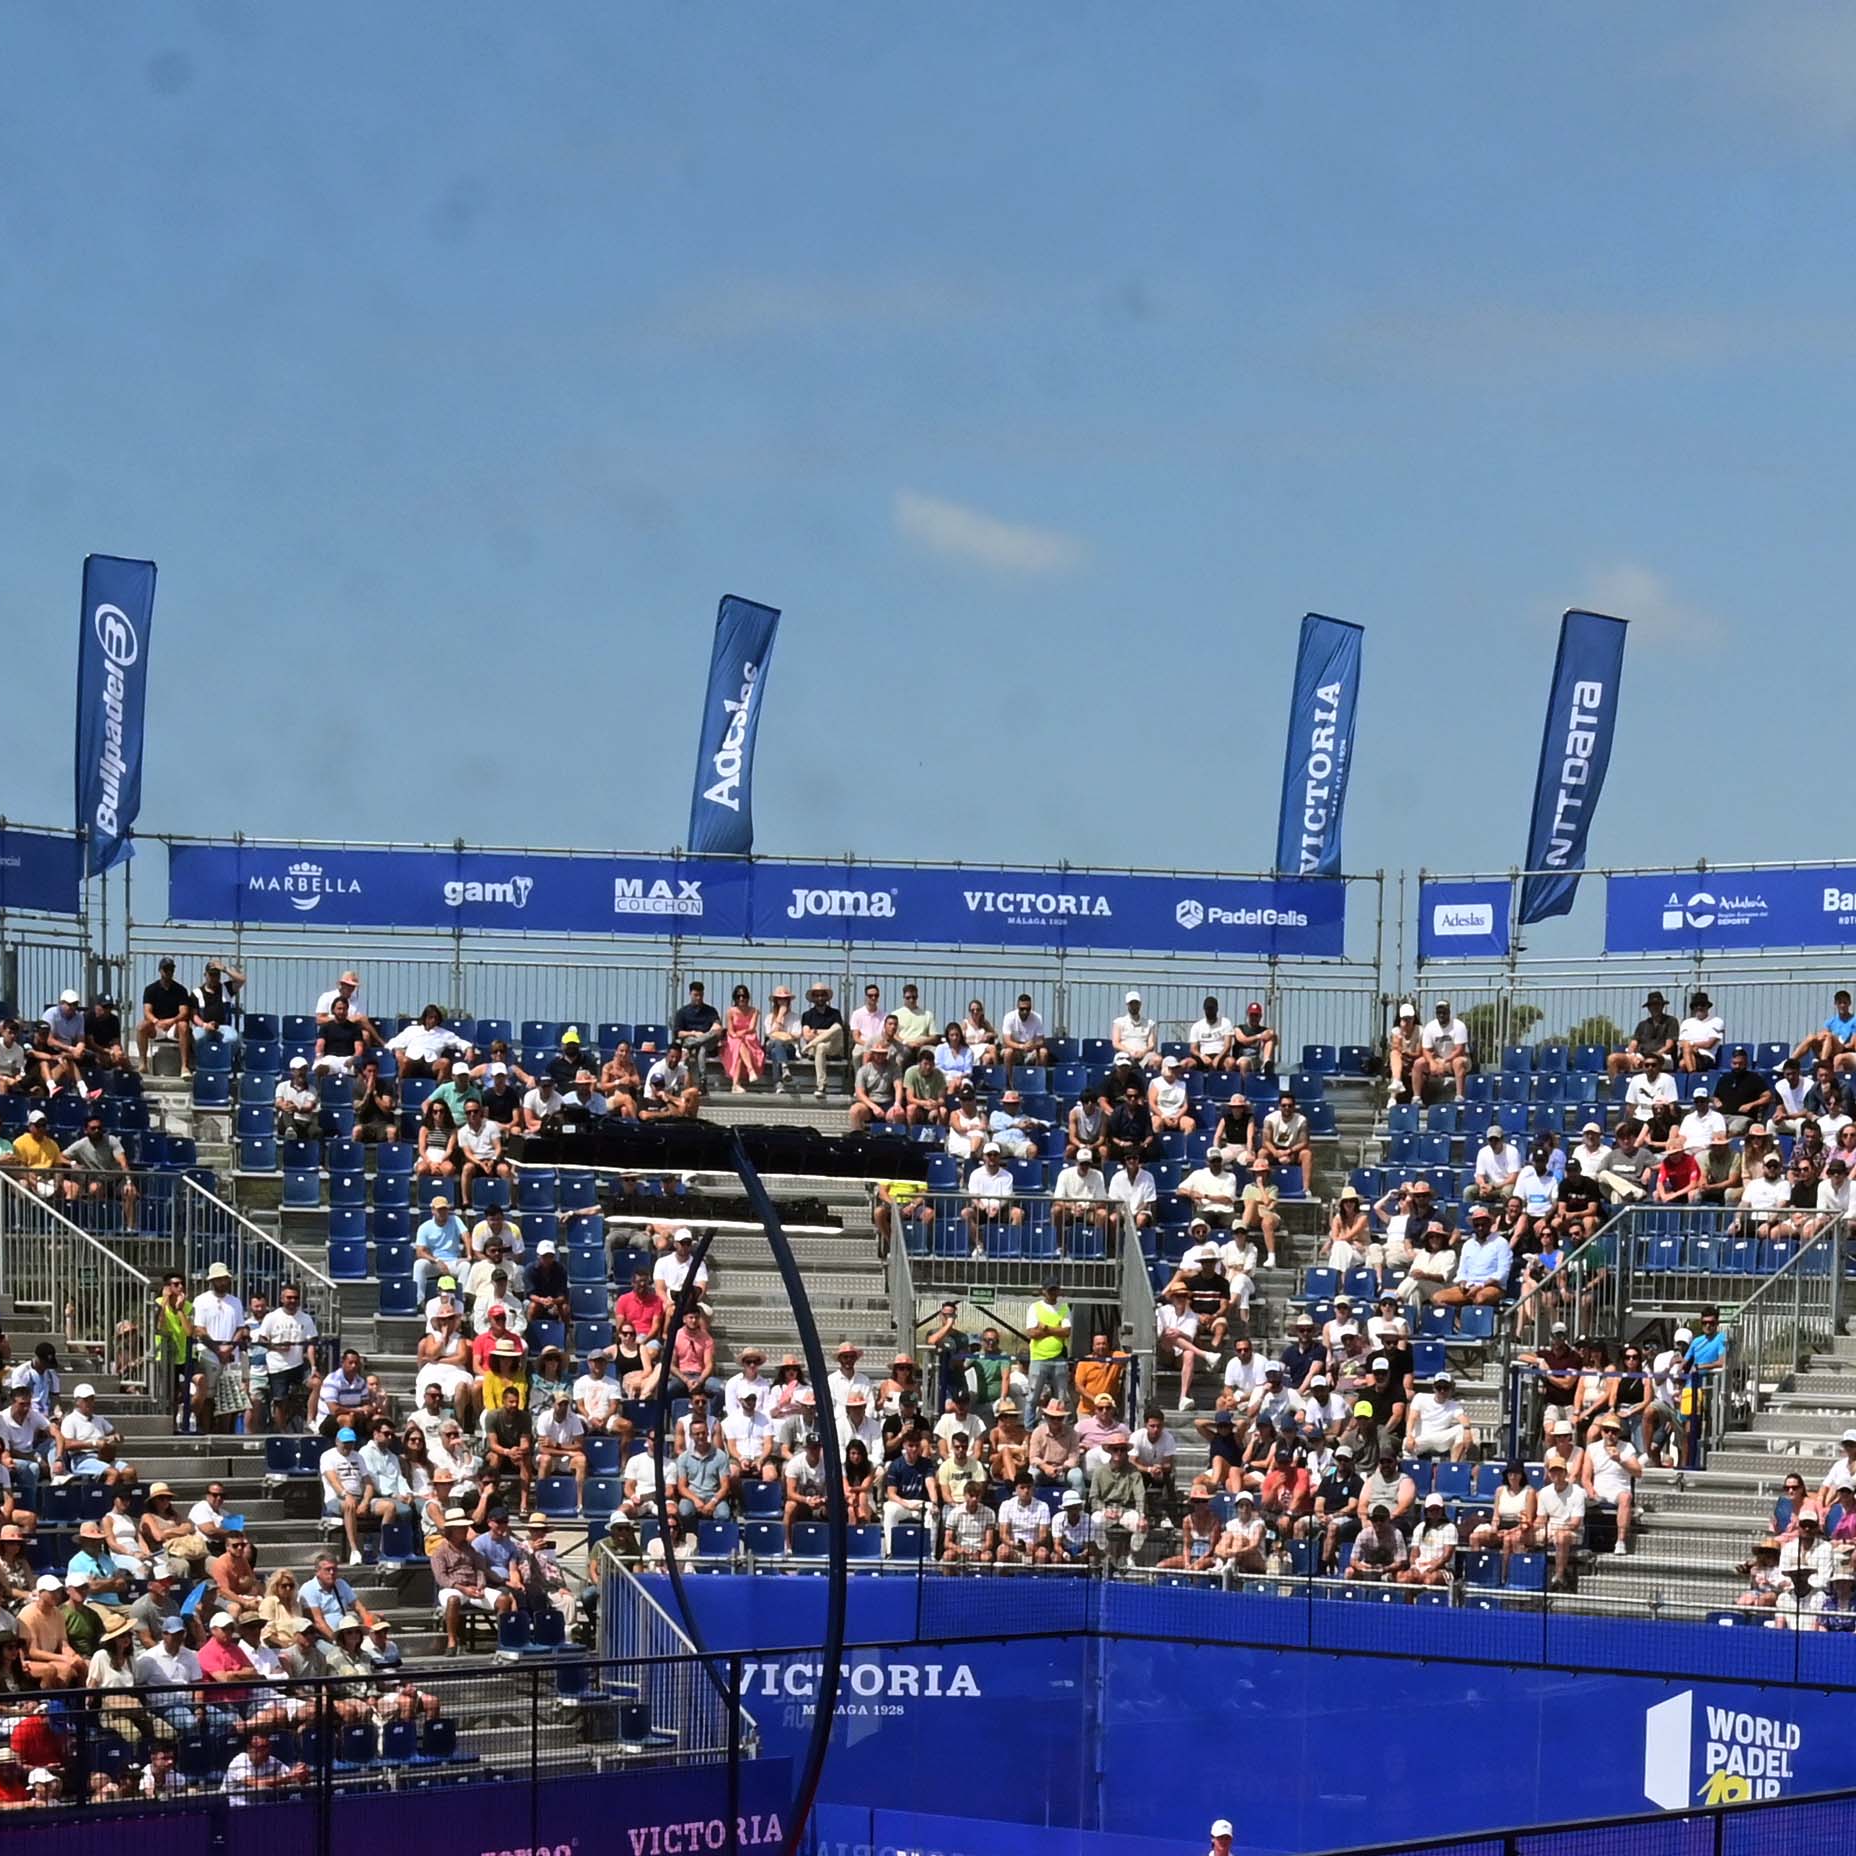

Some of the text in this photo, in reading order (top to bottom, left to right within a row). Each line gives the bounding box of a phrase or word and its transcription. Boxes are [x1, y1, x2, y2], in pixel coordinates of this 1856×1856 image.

[97, 656, 127, 837] Bullpadel
[704, 660, 759, 812] Adeslas
[1299, 680, 1340, 874] VICTORIA
[1546, 793, 1573, 866] NTT
[250, 877, 361, 893] MARBELLA
[445, 882, 510, 906] gam
[615, 879, 702, 899] MAX
[616, 899, 701, 913] COLCHON
[964, 892, 1112, 915] VICTORIA
[1718, 894, 1769, 912] Andalucía
[1209, 908, 1307, 926] PadelGalis
[1442, 912, 1485, 928] Adeslas
[874, 1705, 904, 1715] 1928
[1706, 1706, 1800, 1752] WORLD
[1706, 1742, 1793, 1778] PADEL
